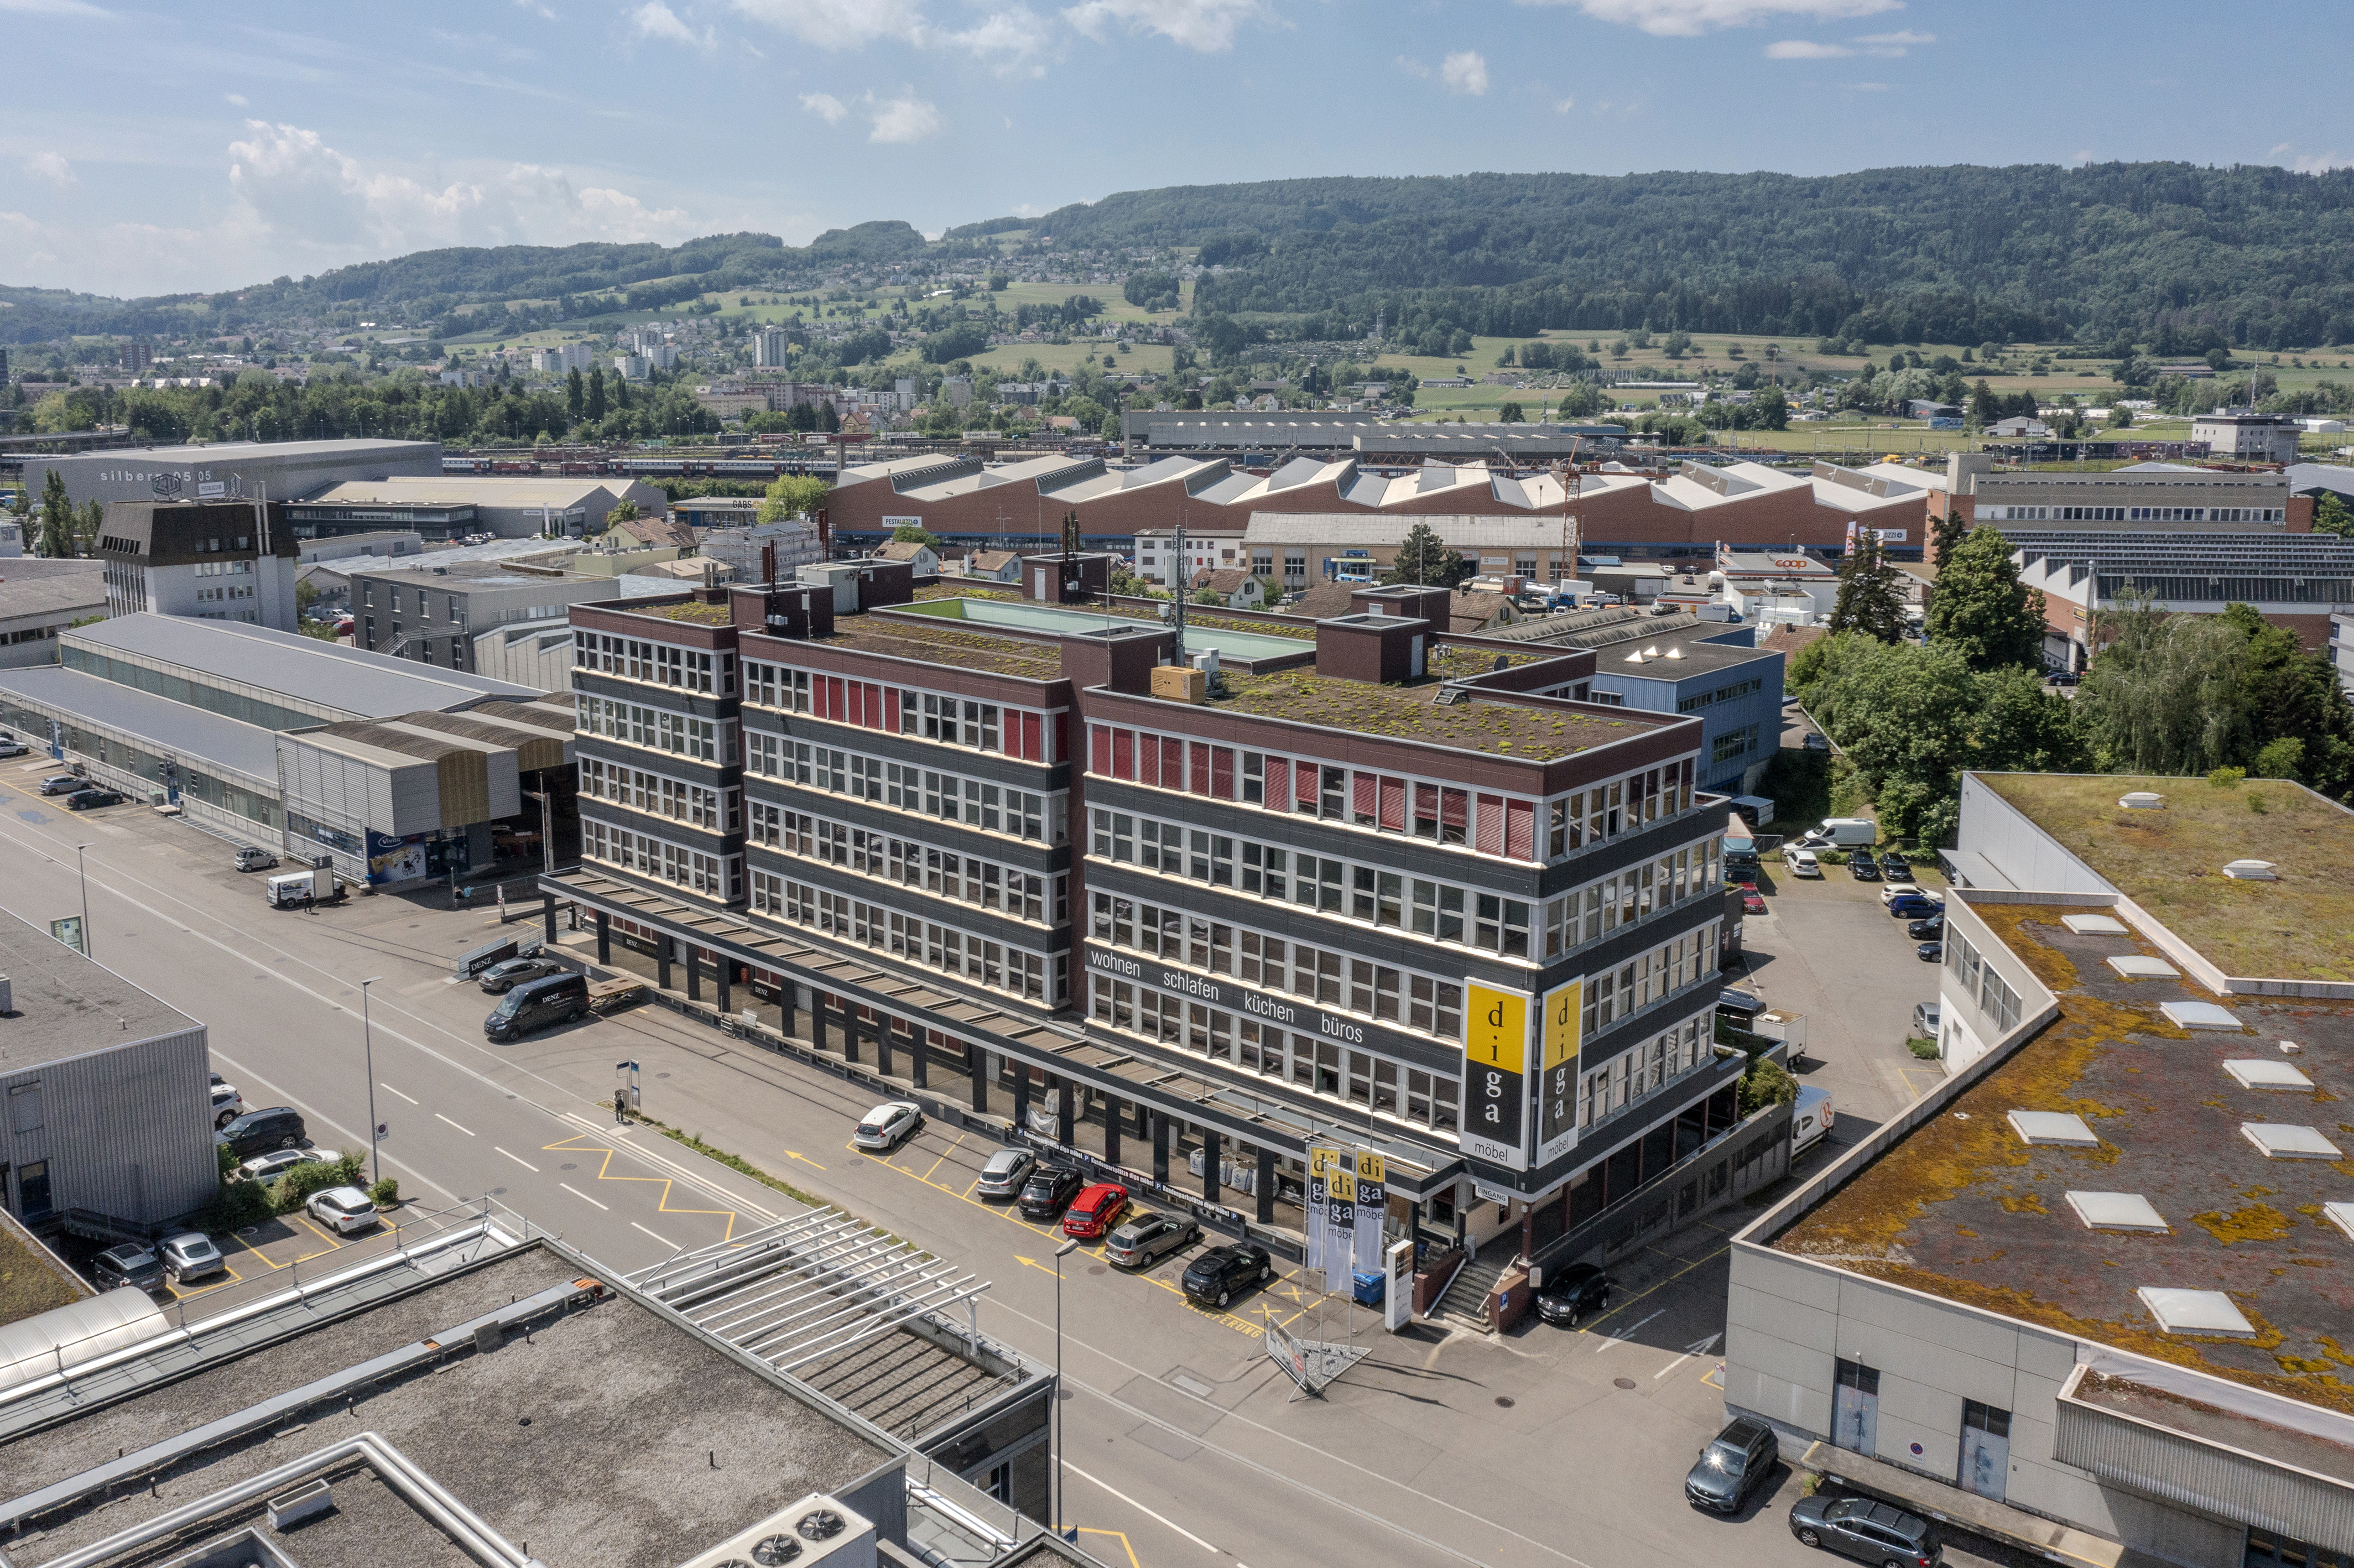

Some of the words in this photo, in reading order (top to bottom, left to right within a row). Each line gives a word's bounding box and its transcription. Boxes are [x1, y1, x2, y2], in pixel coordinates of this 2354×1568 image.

[198, 470, 211, 481] 05
[733, 500, 752, 508] GABS
[1775, 560, 1807, 570] coop
[382, 836, 401, 845] Vivita
[626, 939, 638, 947] DENZ
[471, 957, 493, 971] DENZ
[755, 986, 768, 996] DENZ
[1091, 951, 1140, 977] wohnen
[1164, 971, 1218, 1001] schlafen
[1245, 991, 1294, 1023] küchen
[1322, 1013, 1363, 1043] büros
[543, 993, 560, 1004] DENZ
[1060, 1145, 1069, 1154] diga
[1070, 1149, 1082, 1159] möbel
[1475, 1142, 1508, 1162] möbel
[1548, 1139, 1569, 1159] möbel
[1091, 1157, 1129, 1178] Kundenparkplätze
[1129, 1173, 1139, 1181] diga
[1140, 1177, 1154, 1187] möbel
[1361, 1157, 1381, 1177] di
[1332, 1175, 1352, 1196] di
[1163, 1185, 1204, 1206] Kundenparkplätze
[1204, 1201, 1215, 1211] diga
[1215, 1206, 1230, 1217] möbel
[1360, 1185, 1383, 1203] ga
[1478, 1187, 1506, 1201] EINGANG
[1330, 1204, 1353, 1222] ga
[1160, 1279, 1175, 1288] diga
